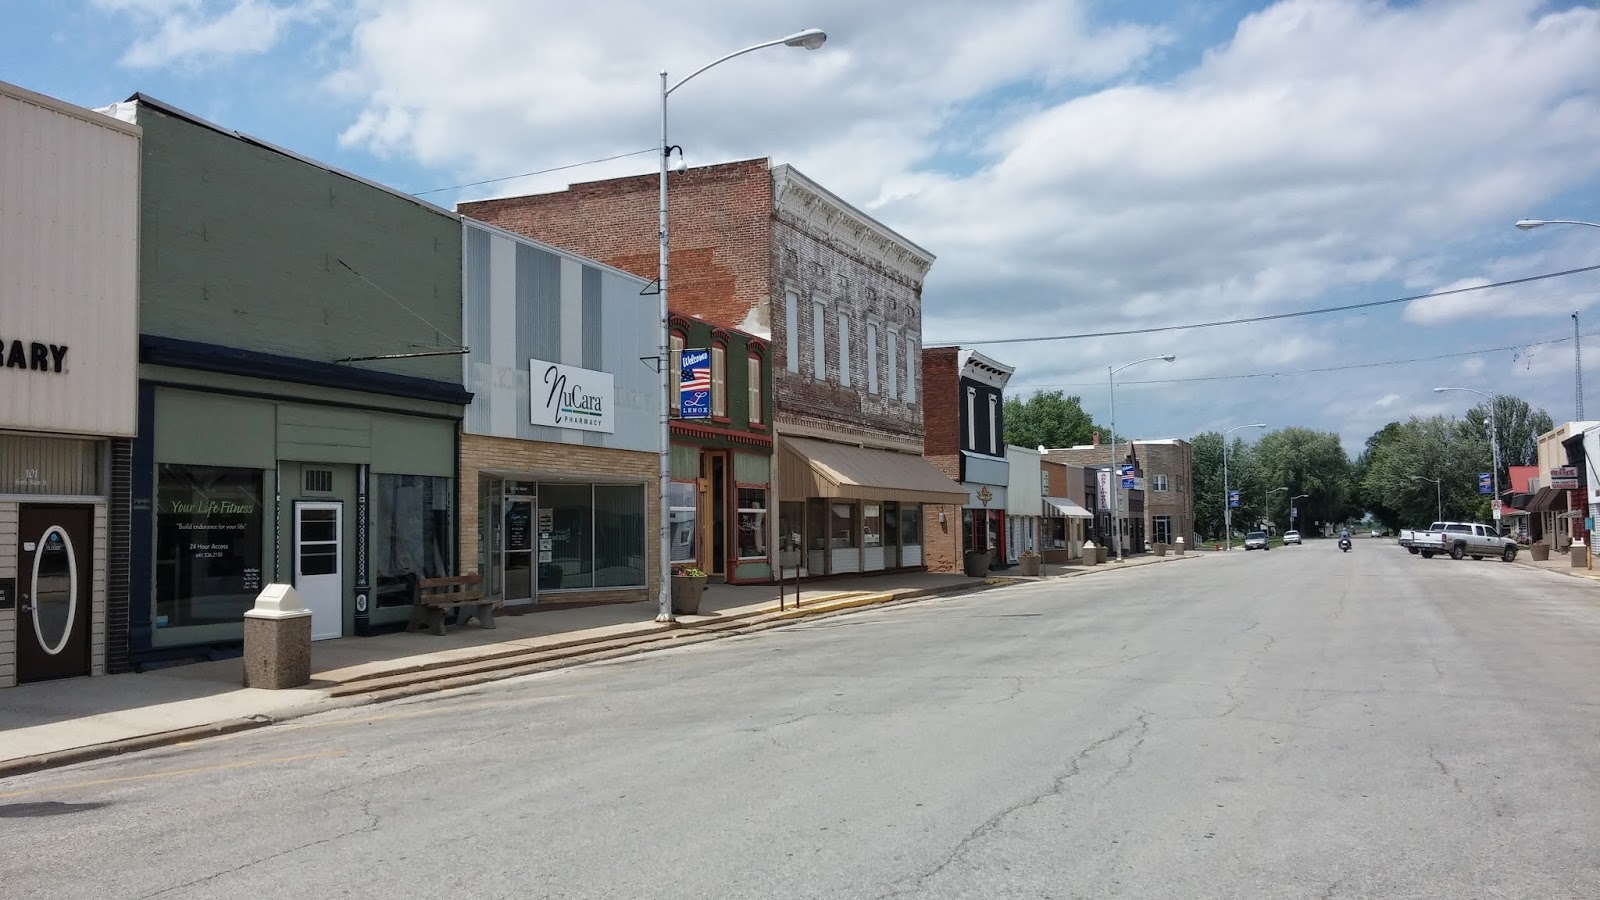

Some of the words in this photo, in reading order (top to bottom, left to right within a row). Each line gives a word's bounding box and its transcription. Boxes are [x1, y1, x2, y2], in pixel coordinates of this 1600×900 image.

[0, 339, 68, 373] ARY
[682, 352, 709, 368] Welcome
[544, 365, 602, 424] NuCara
[564, 415, 602, 427] PHARMACY
[172, 500, 195, 513] Your
[197, 500, 220, 518] Life
[220, 501, 253, 514] Fitness
